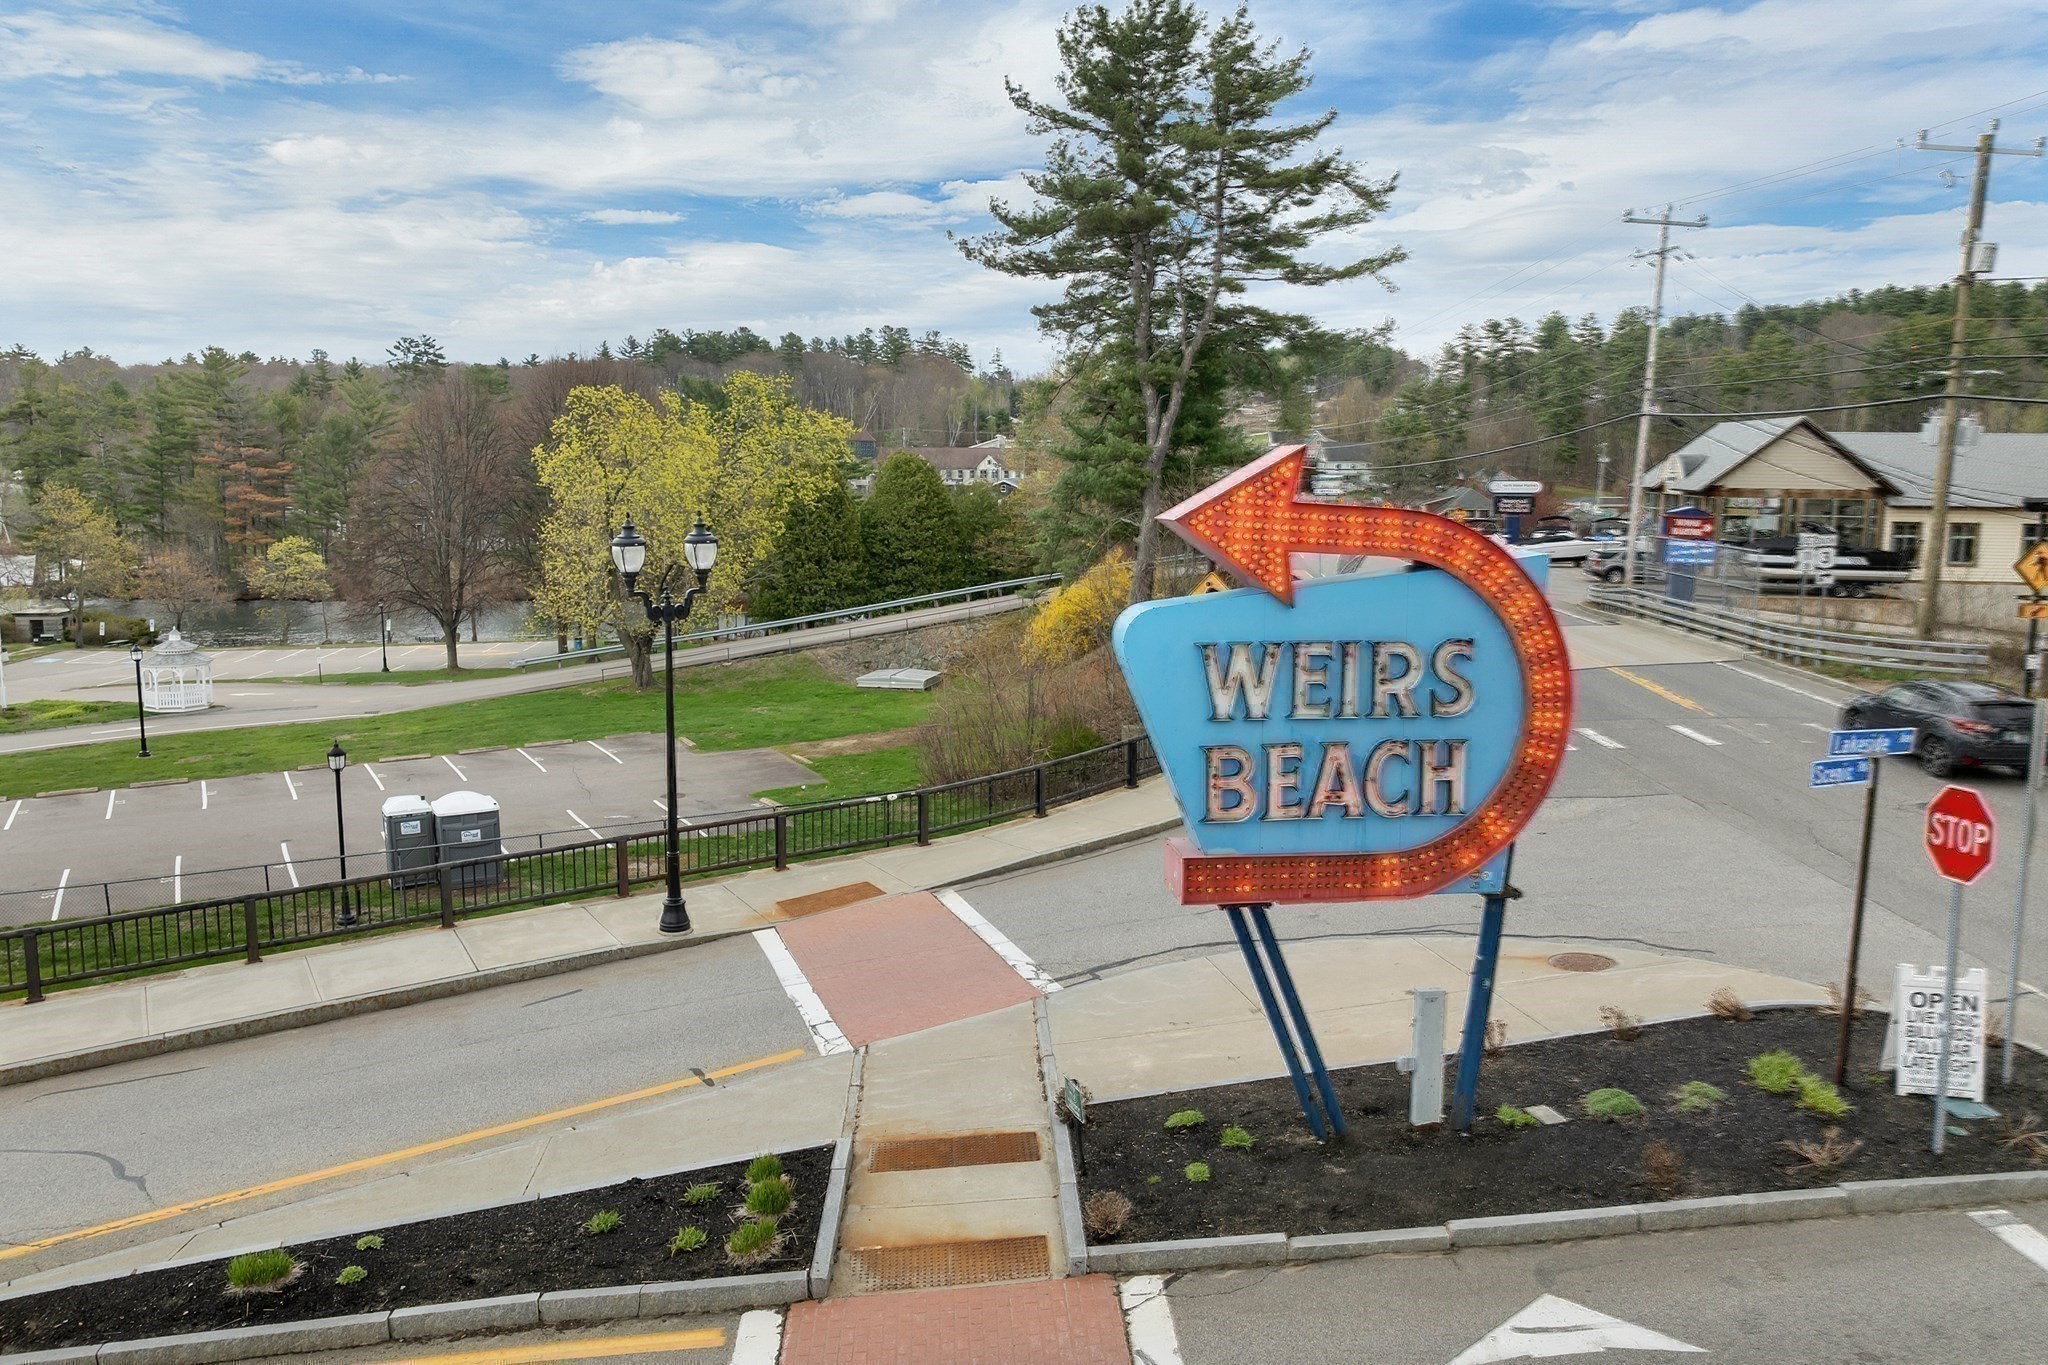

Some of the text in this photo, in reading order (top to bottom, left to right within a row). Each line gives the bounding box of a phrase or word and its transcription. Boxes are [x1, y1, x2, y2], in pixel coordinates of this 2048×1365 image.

[1195, 638, 1474, 722] WEIRS
[1199, 739, 1470, 824] BEACH
[1927, 812, 1991, 857] STOP
[1909, 992, 1978, 1012] OPEN
